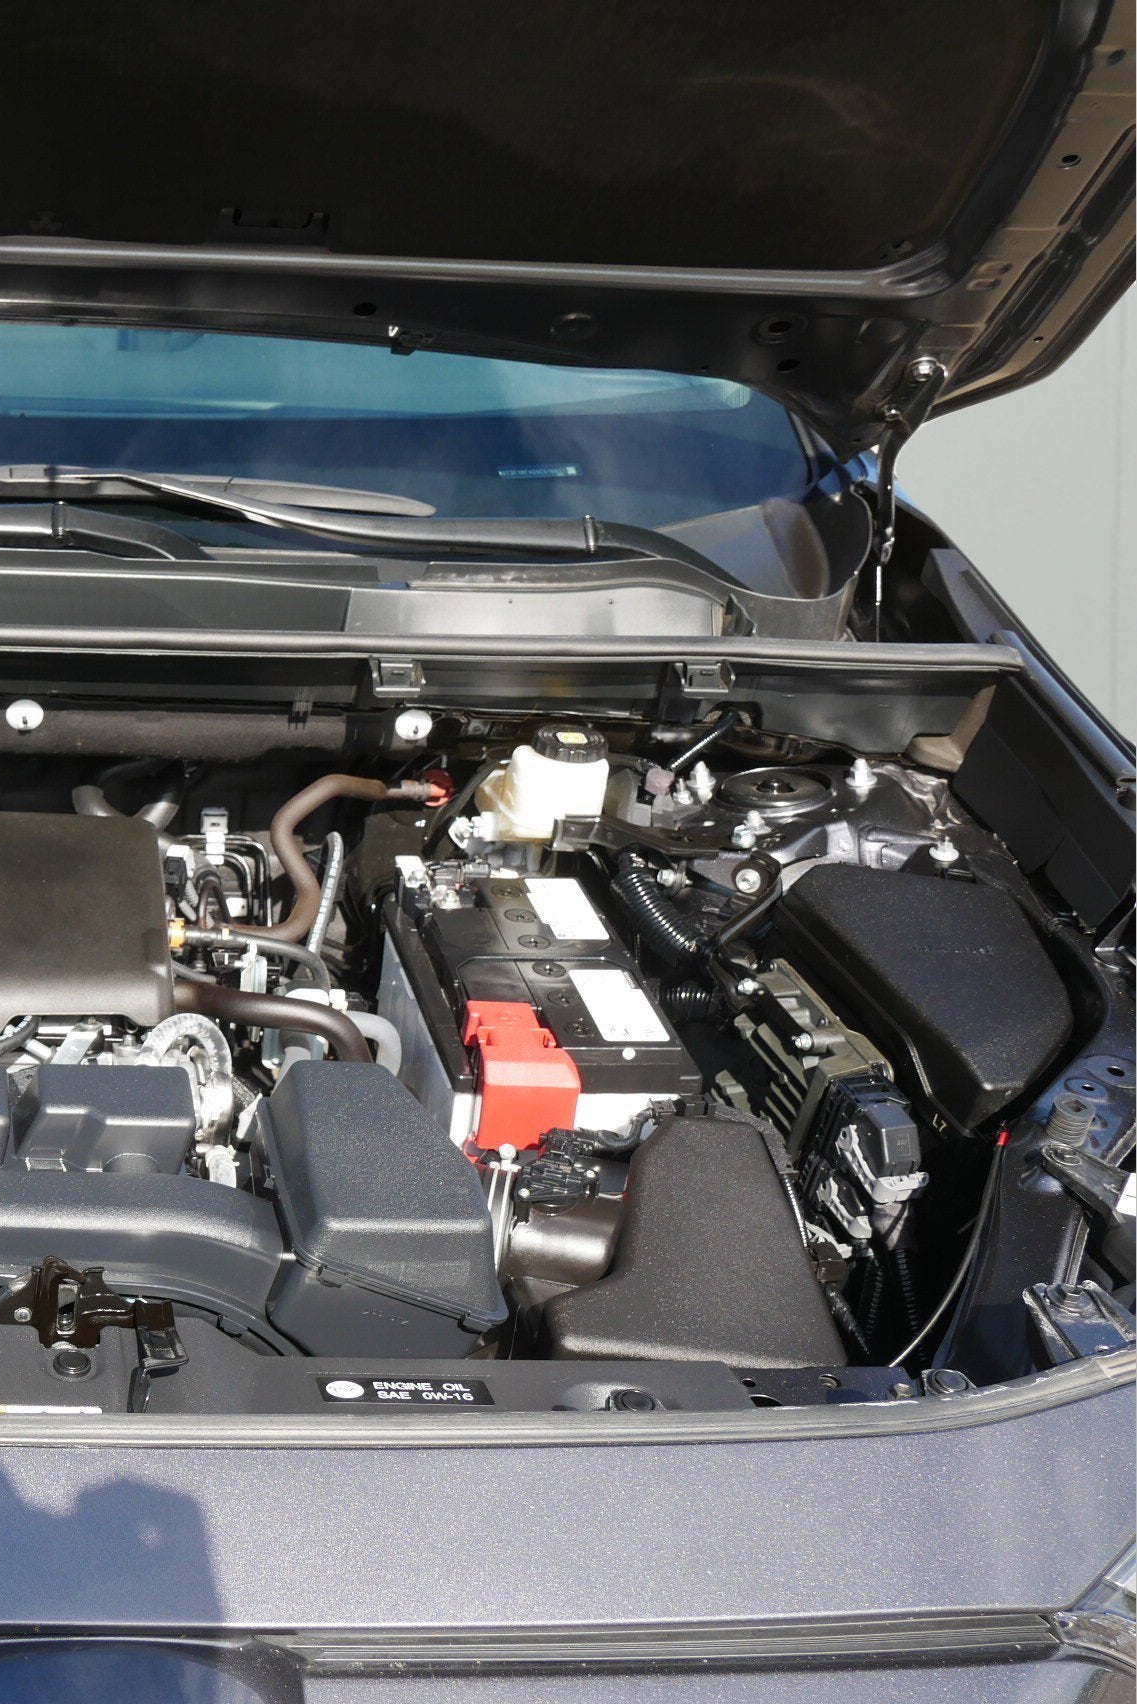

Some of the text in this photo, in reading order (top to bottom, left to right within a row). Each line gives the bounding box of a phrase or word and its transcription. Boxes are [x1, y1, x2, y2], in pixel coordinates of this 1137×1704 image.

[372, 1381, 471, 1392] ENGINE OIL
[377, 1390, 474, 1401] SAE 0W-16
